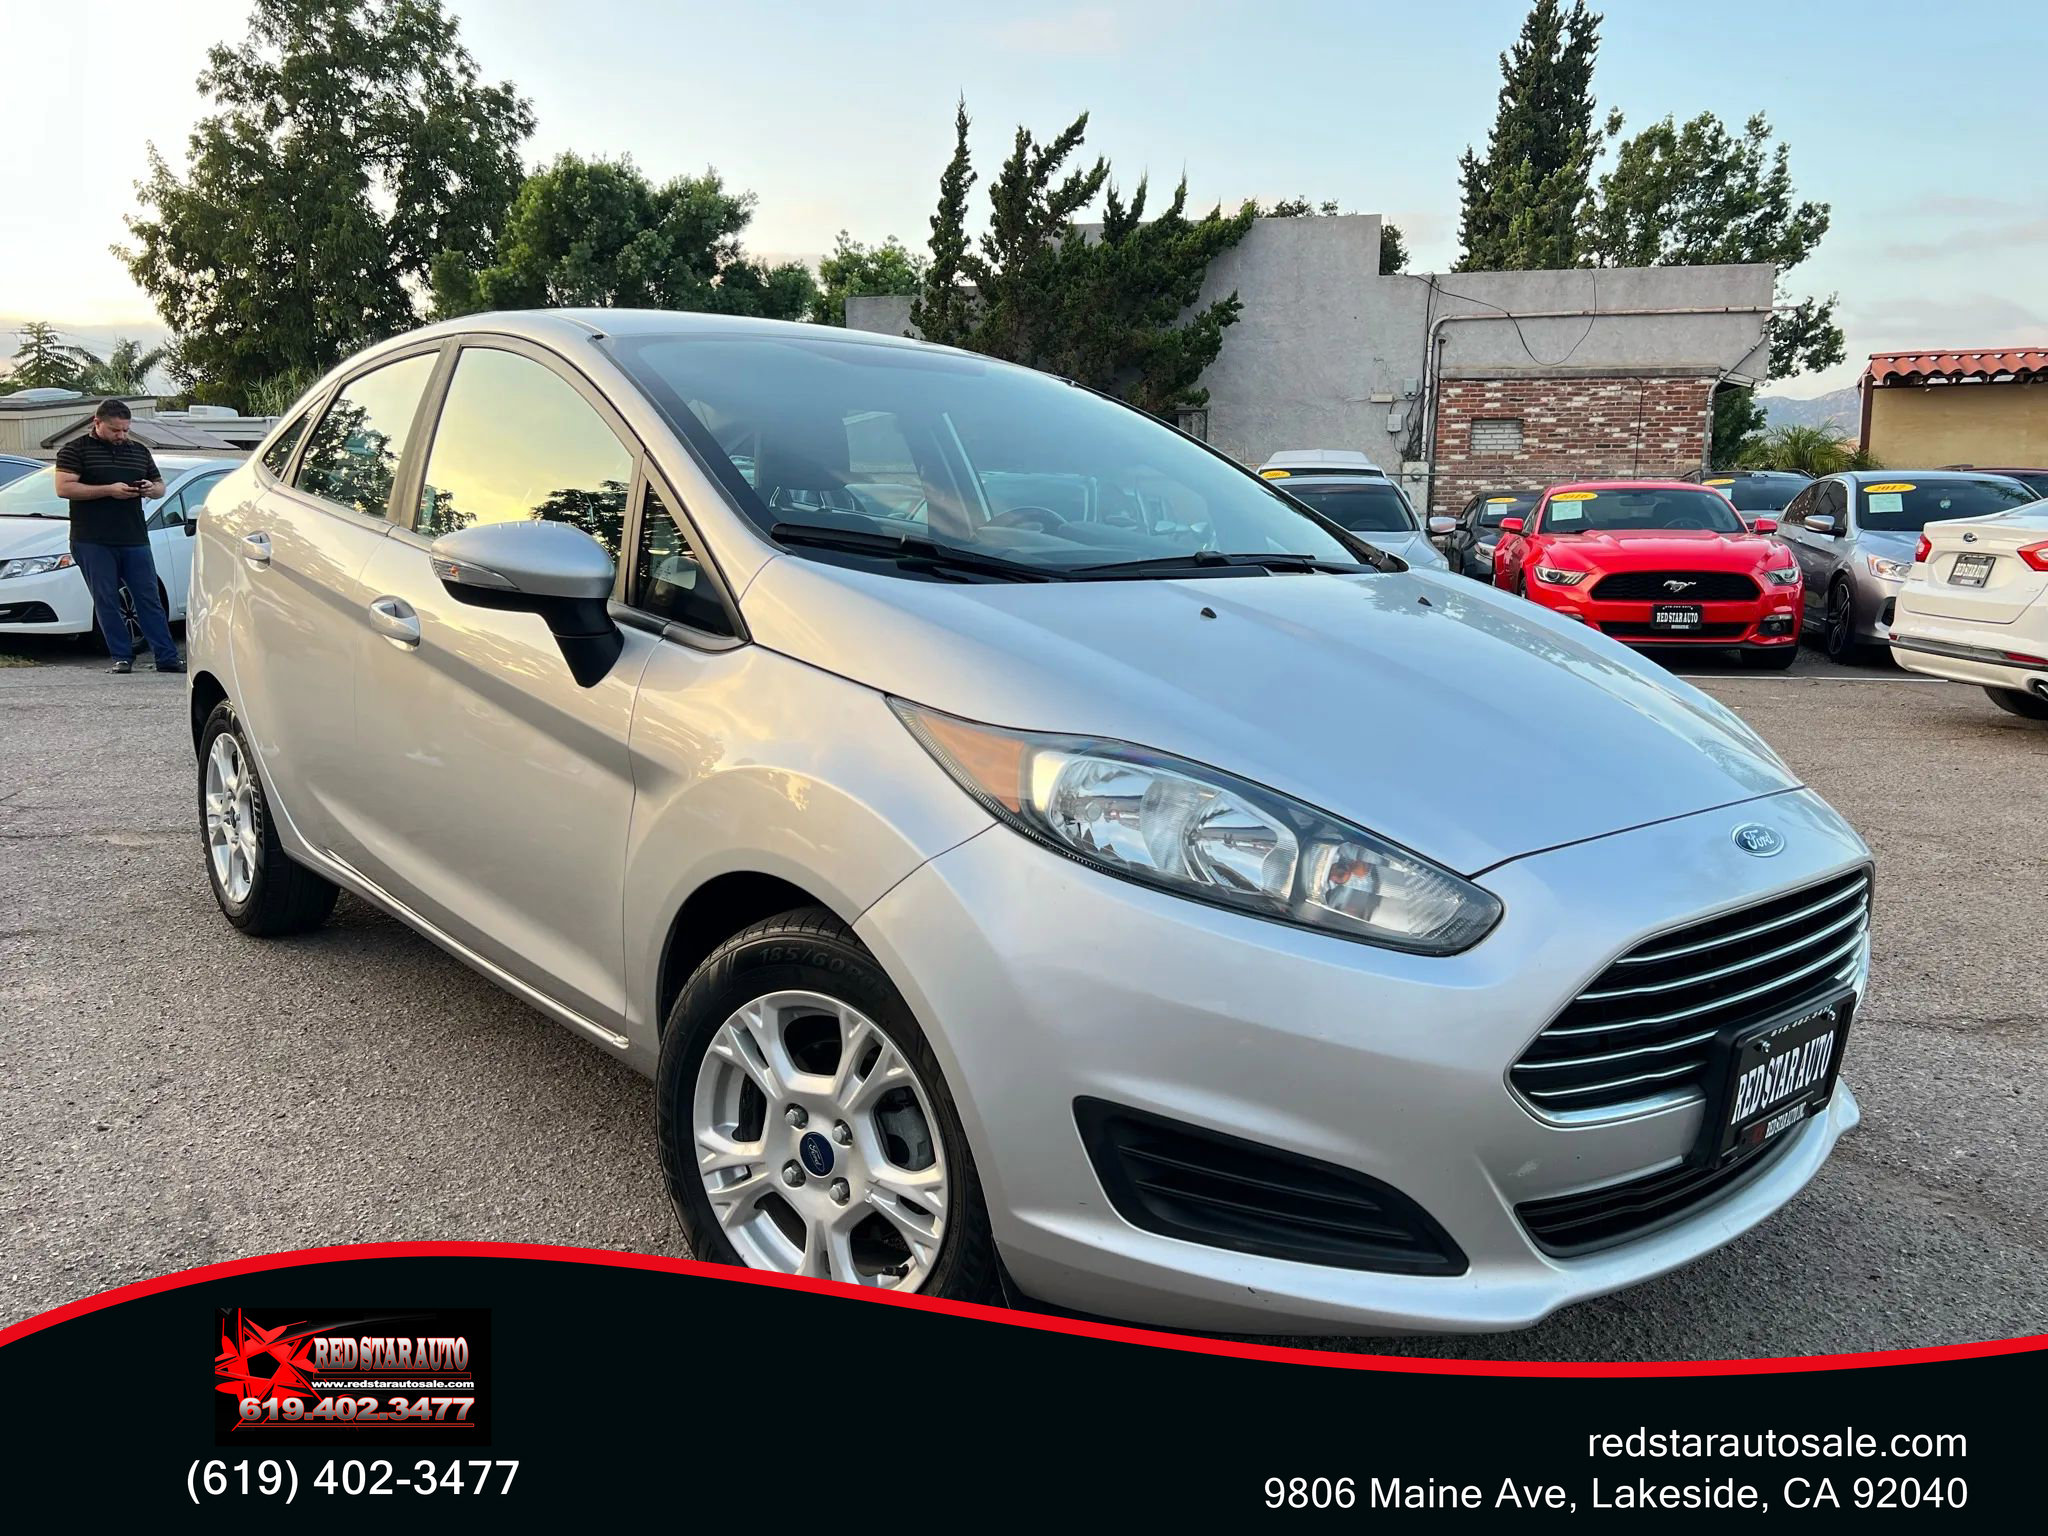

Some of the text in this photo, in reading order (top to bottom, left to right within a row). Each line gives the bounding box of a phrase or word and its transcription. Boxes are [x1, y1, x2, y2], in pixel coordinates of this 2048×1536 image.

[1656, 612, 1699, 623] RED STAR AUTO
[1743, 829, 1775, 850] Ford
[1731, 1030, 1834, 1125] RED STAR AUTO
